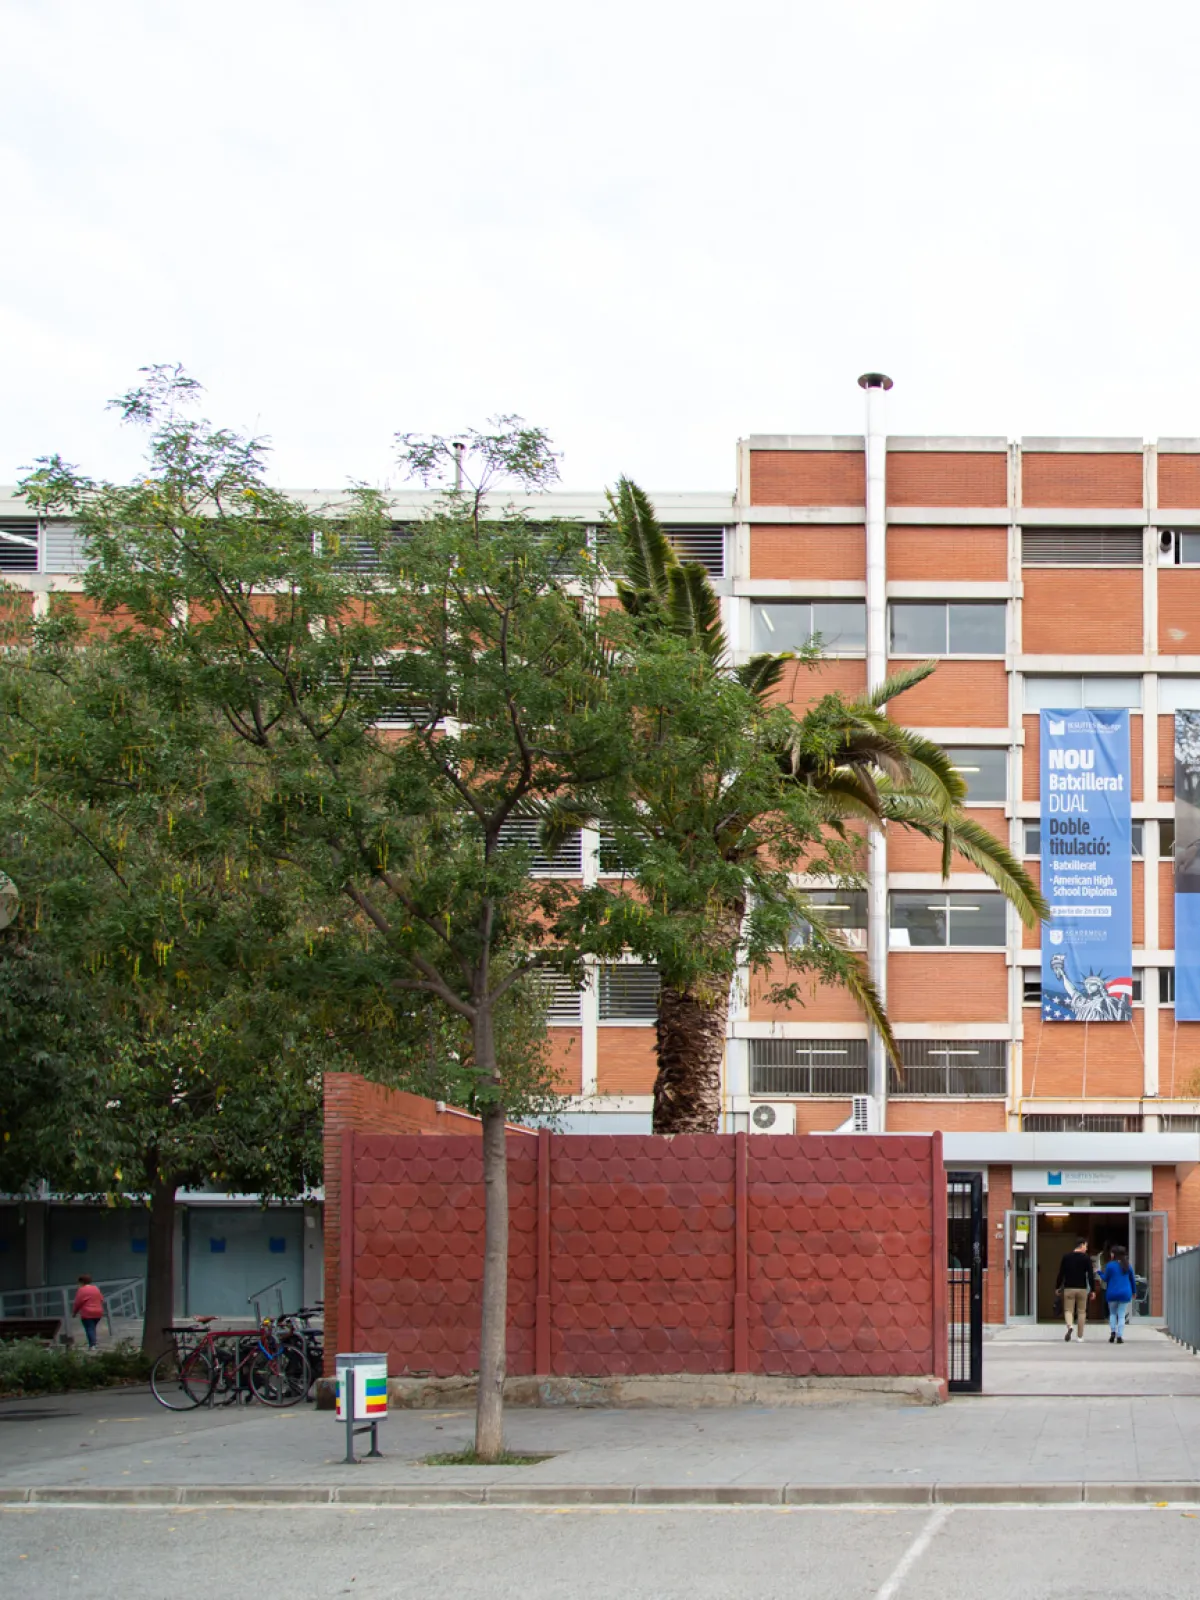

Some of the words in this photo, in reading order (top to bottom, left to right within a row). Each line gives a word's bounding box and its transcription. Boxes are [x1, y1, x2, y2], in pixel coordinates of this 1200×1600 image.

[1049, 749, 1094, 770] NOU
[1049, 772, 1123, 791] Batxillerat
[1049, 794, 1088, 812] DUAL
[1049, 818, 1090, 835] Doble
[1049, 836, 1110, 855] titulació:
[1053, 875, 1092, 885] American
[1093, 875, 1113, 887] High
[1053, 886, 1081, 896] School
[1082, 886, 1118, 898] Diploma
